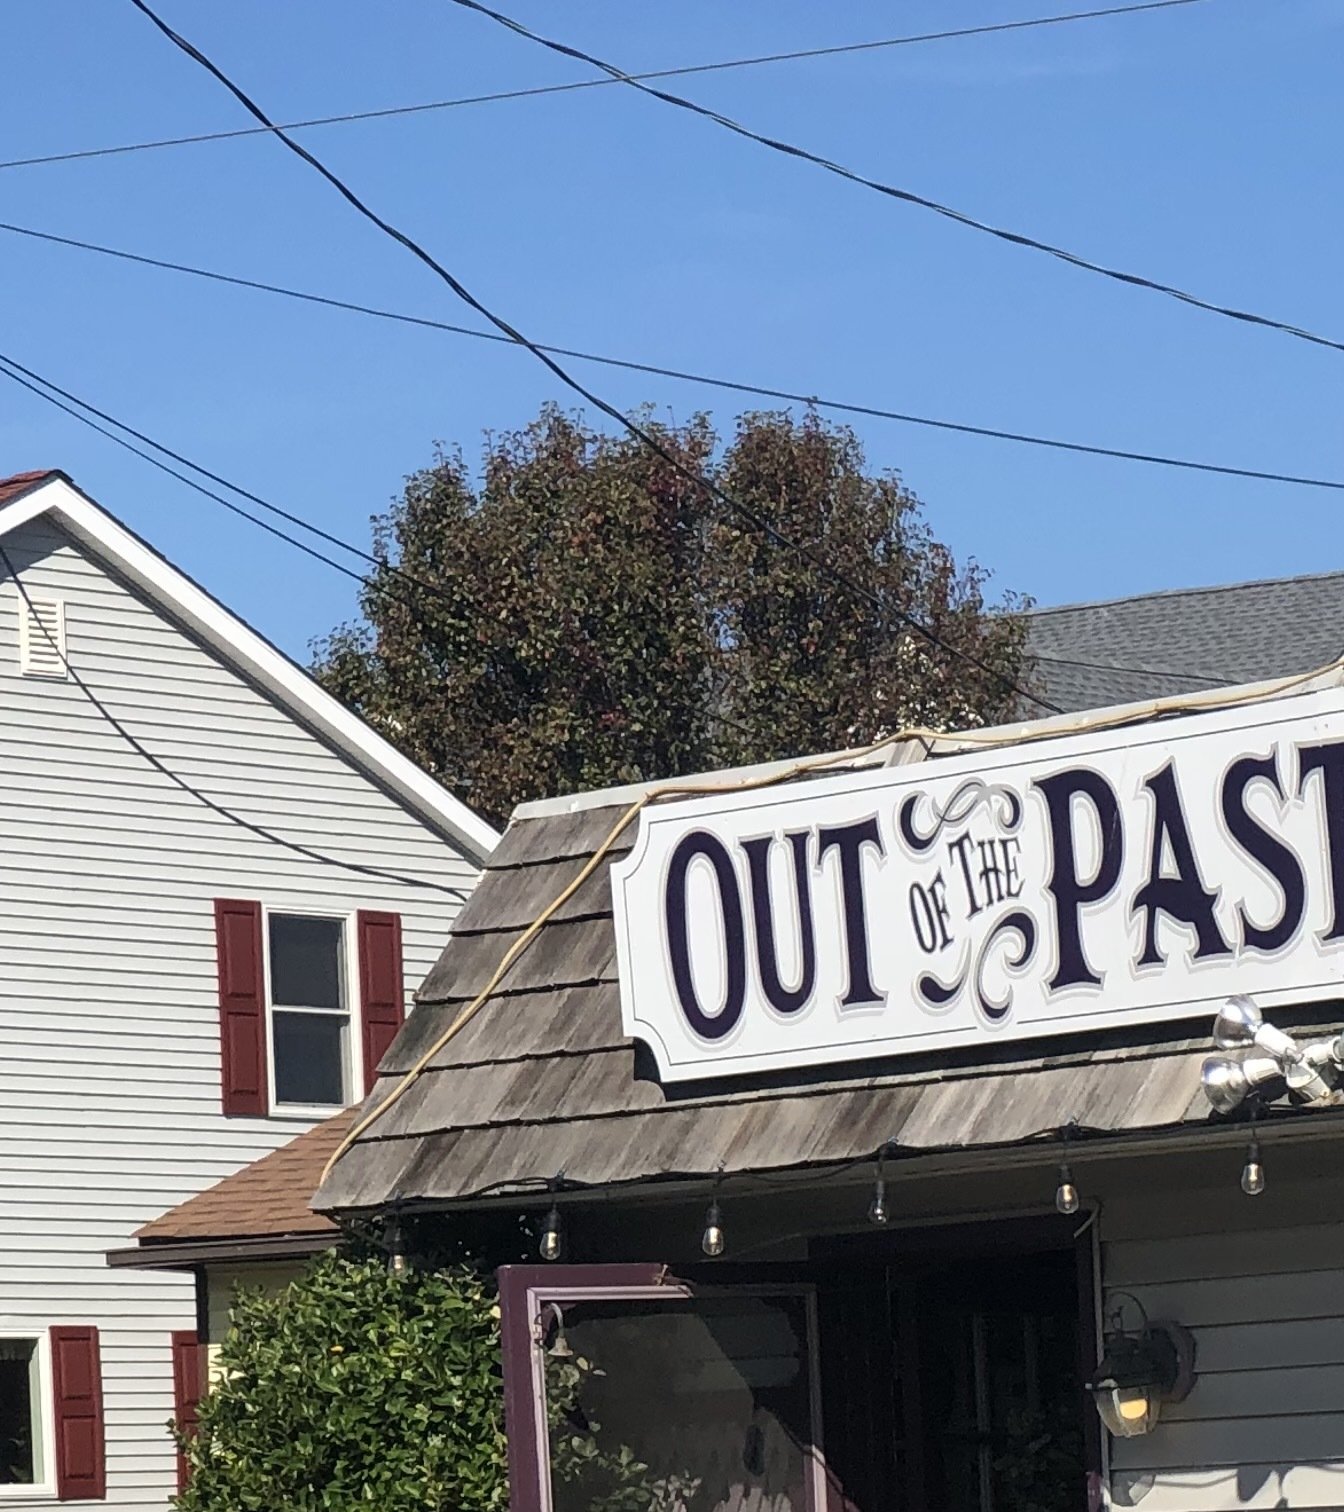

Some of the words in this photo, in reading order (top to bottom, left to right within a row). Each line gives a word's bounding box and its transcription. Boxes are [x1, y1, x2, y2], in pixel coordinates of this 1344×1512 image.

[664, 813, 886, 1041] OUT
[909, 867, 955, 954] OF
[947, 828, 1027, 922] THE
